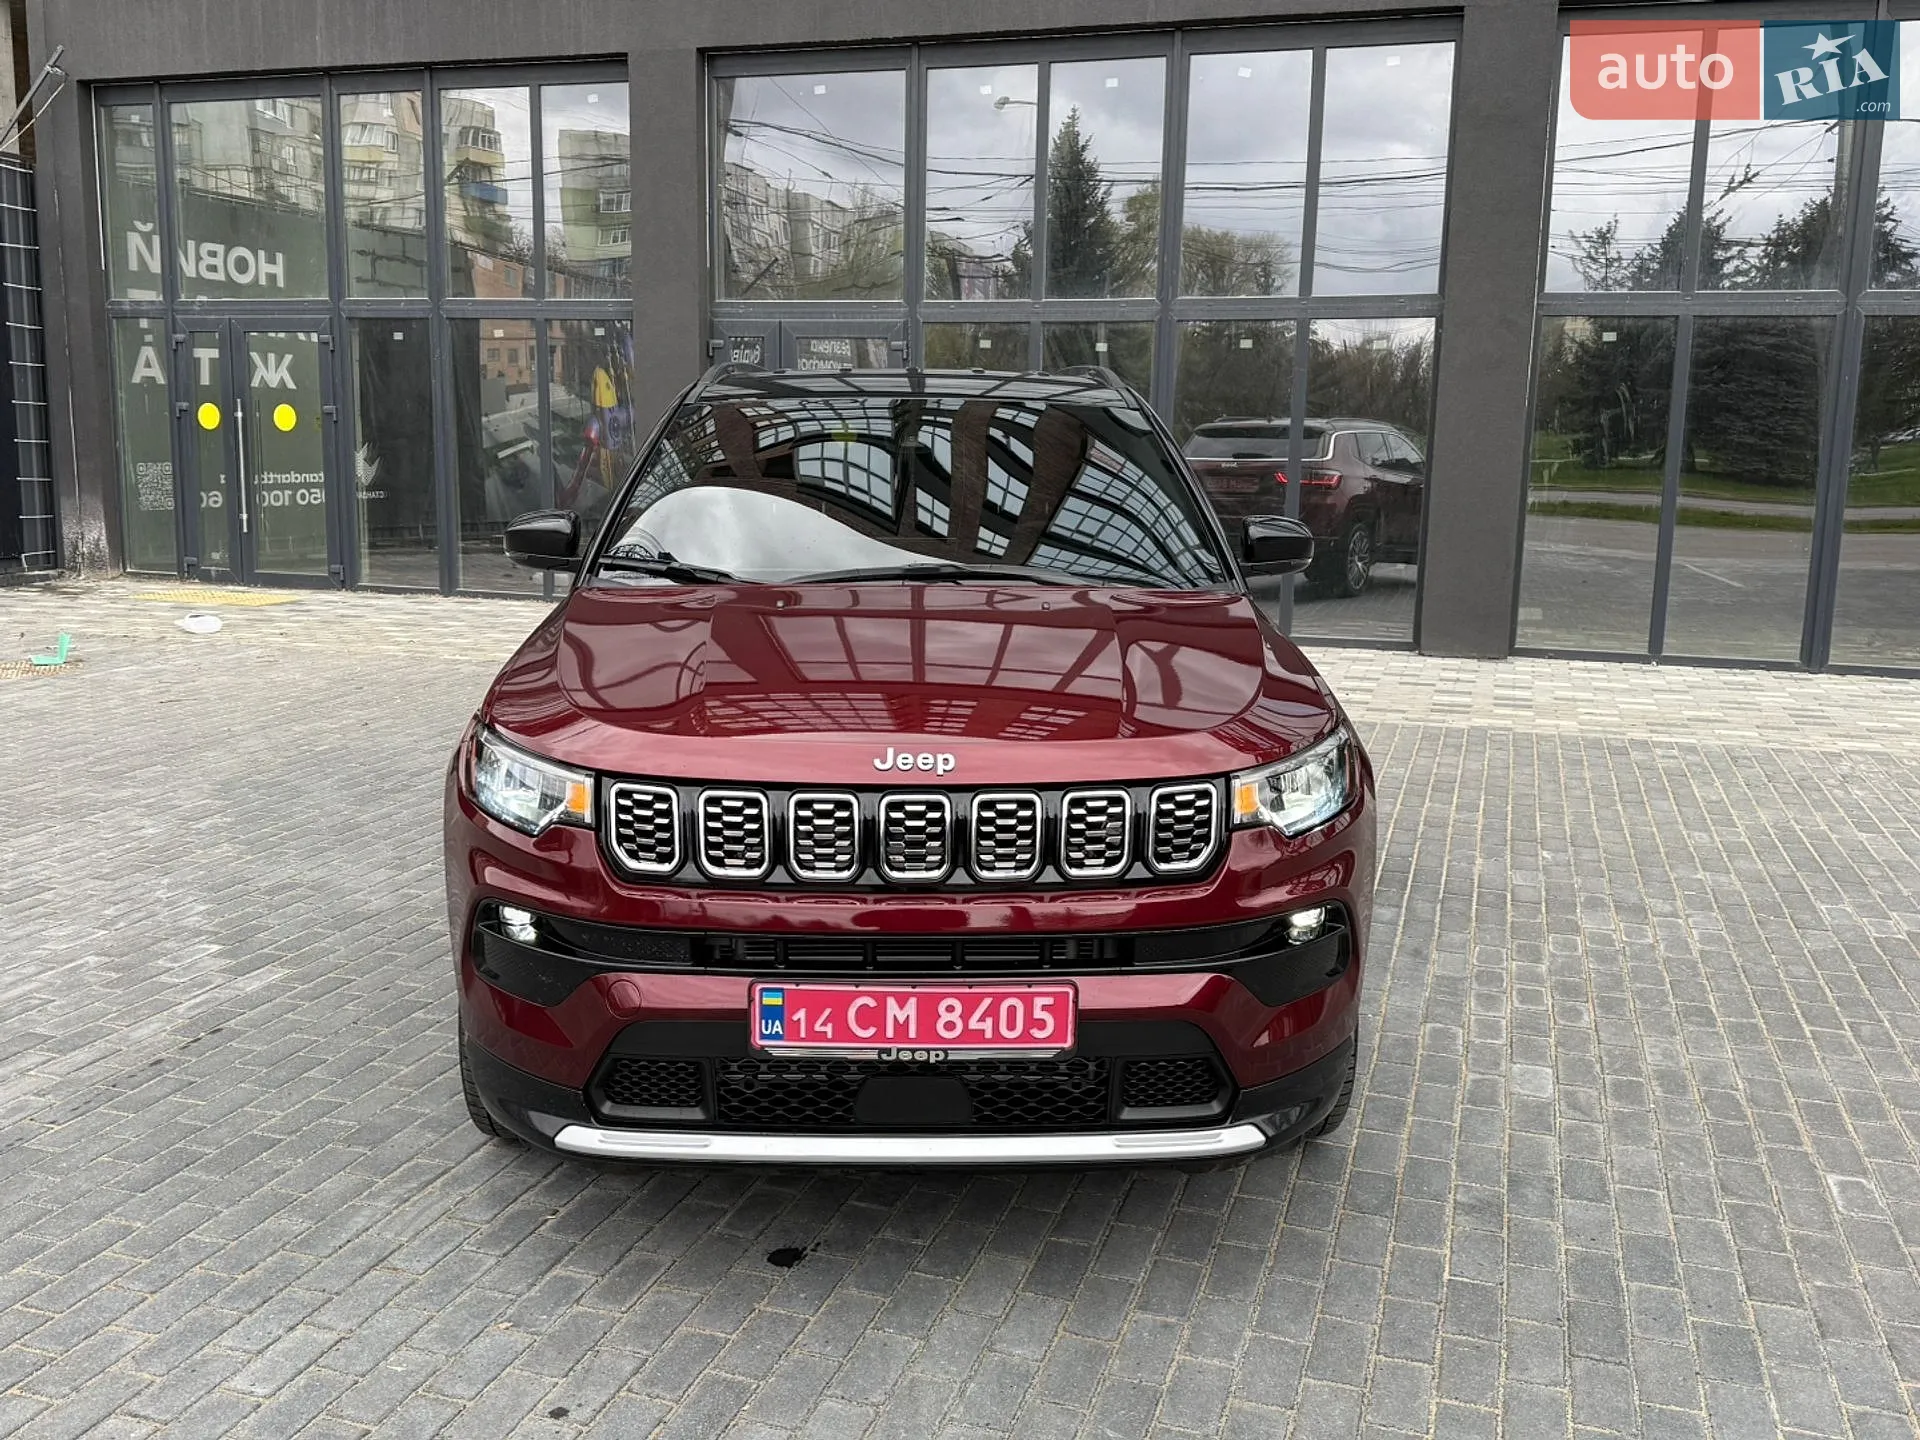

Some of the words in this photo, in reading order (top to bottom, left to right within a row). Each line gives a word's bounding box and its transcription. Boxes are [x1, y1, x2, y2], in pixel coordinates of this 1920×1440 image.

[873, 747, 955, 777] Jeep
[761, 1019, 783, 1035] UA
[792, 1008, 834, 1039] 14
[848, 996, 918, 1039] CM
[936, 997, 1055, 1040] 8405
[881, 1047, 946, 1063] Jeep
